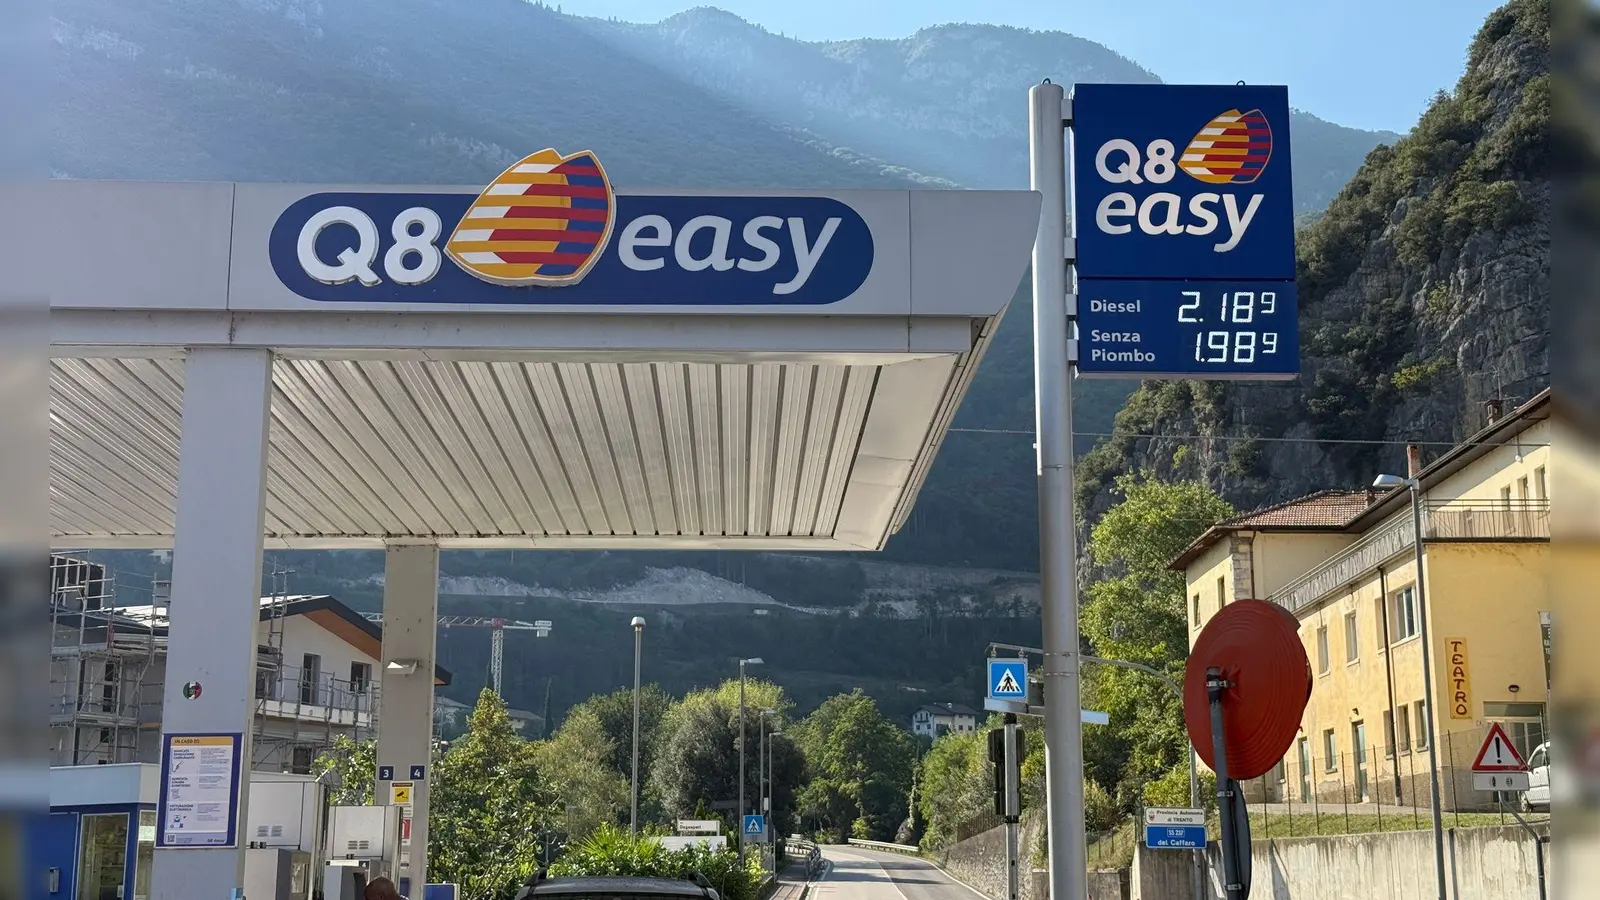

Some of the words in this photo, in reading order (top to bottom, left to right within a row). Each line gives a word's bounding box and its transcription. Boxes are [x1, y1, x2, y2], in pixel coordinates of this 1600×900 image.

[1095, 138, 1177, 185] Q8
[1095, 191, 1265, 253] easy
[297, 206, 443, 287] Q8
[617, 214, 843, 295] easy
[1090, 299, 1141, 313] Diesel
[1091, 329, 1141, 343] Senza
[1091, 348, 1156, 363] Piombo
[1450, 640, 1468, 716] TEATRO
[382, 769, 390, 778] 3
[413, 768, 421, 778] 4
